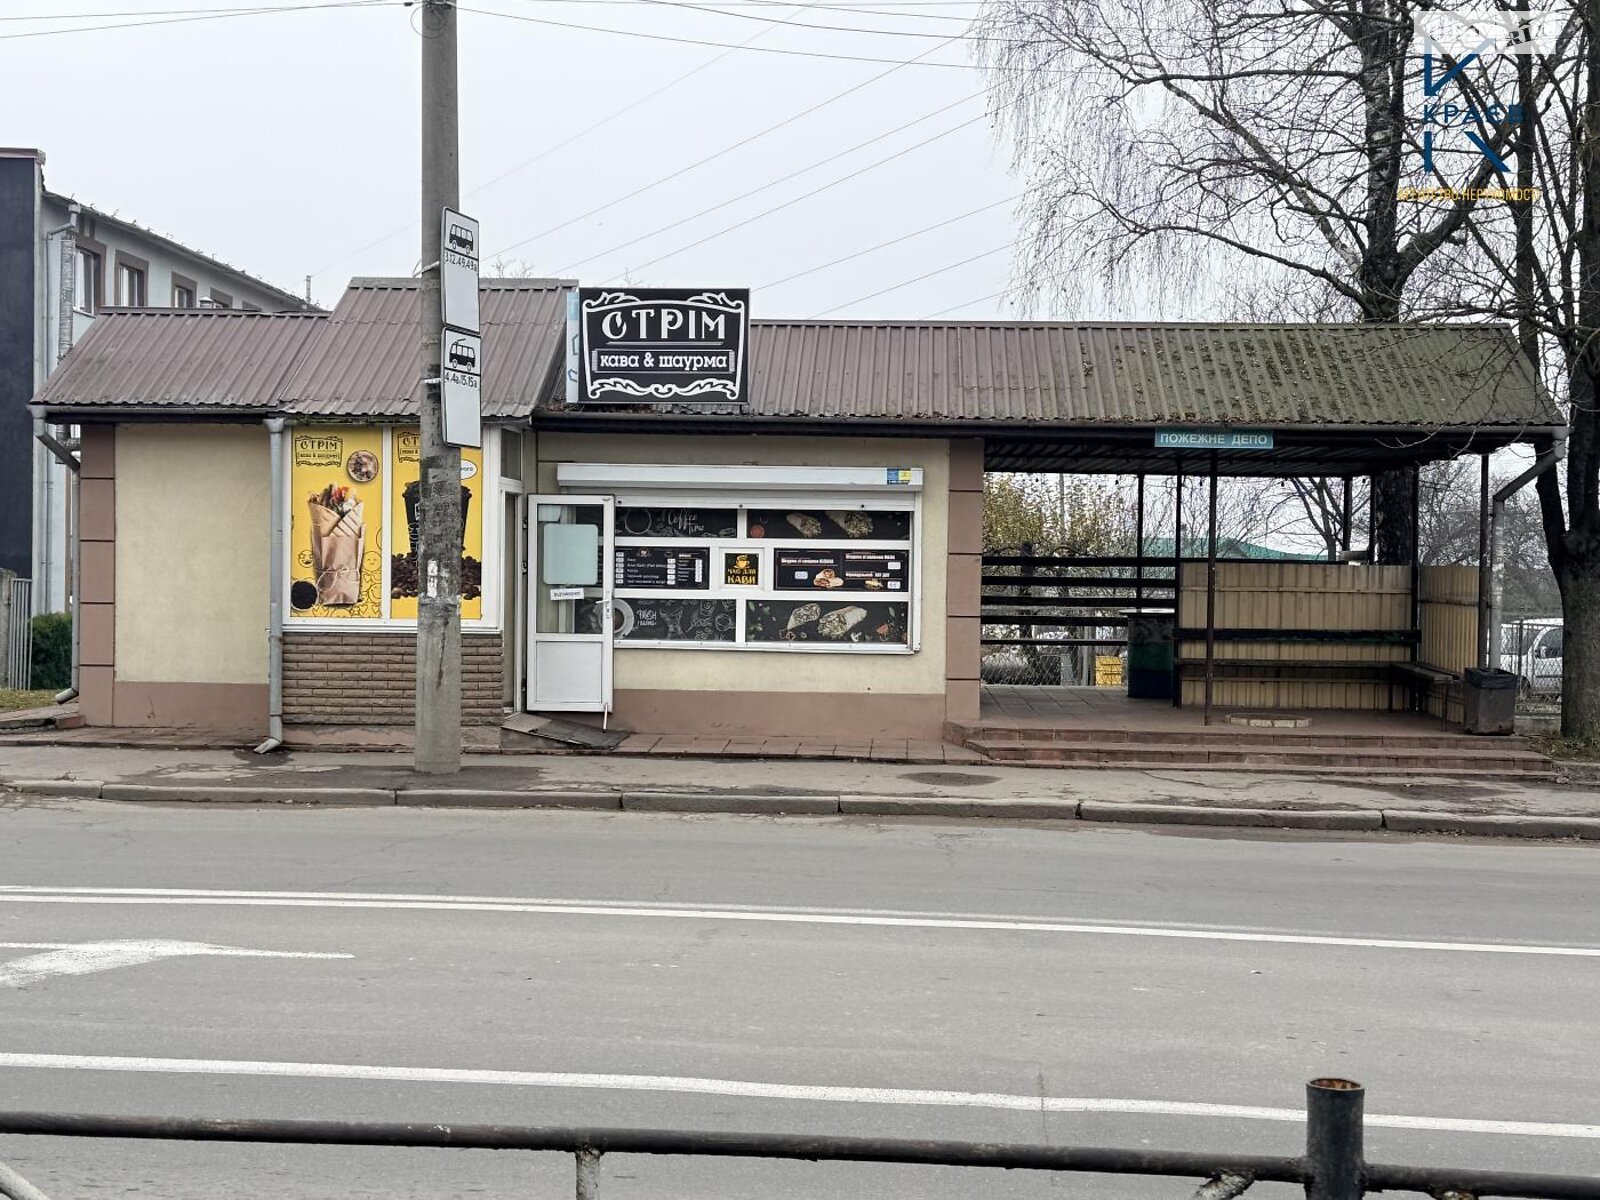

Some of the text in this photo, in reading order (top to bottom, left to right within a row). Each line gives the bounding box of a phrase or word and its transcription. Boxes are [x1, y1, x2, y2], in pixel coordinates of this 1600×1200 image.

[602, 308, 726, 340] СТРІМ
[600, 352, 727, 371] кава & шаурма
[300, 440, 337, 450] СТРІМ
[1160, 433, 1267, 446] ПОЖЕЖНЕ ДЕПО
[727, 575, 756, 584] КАВИ
